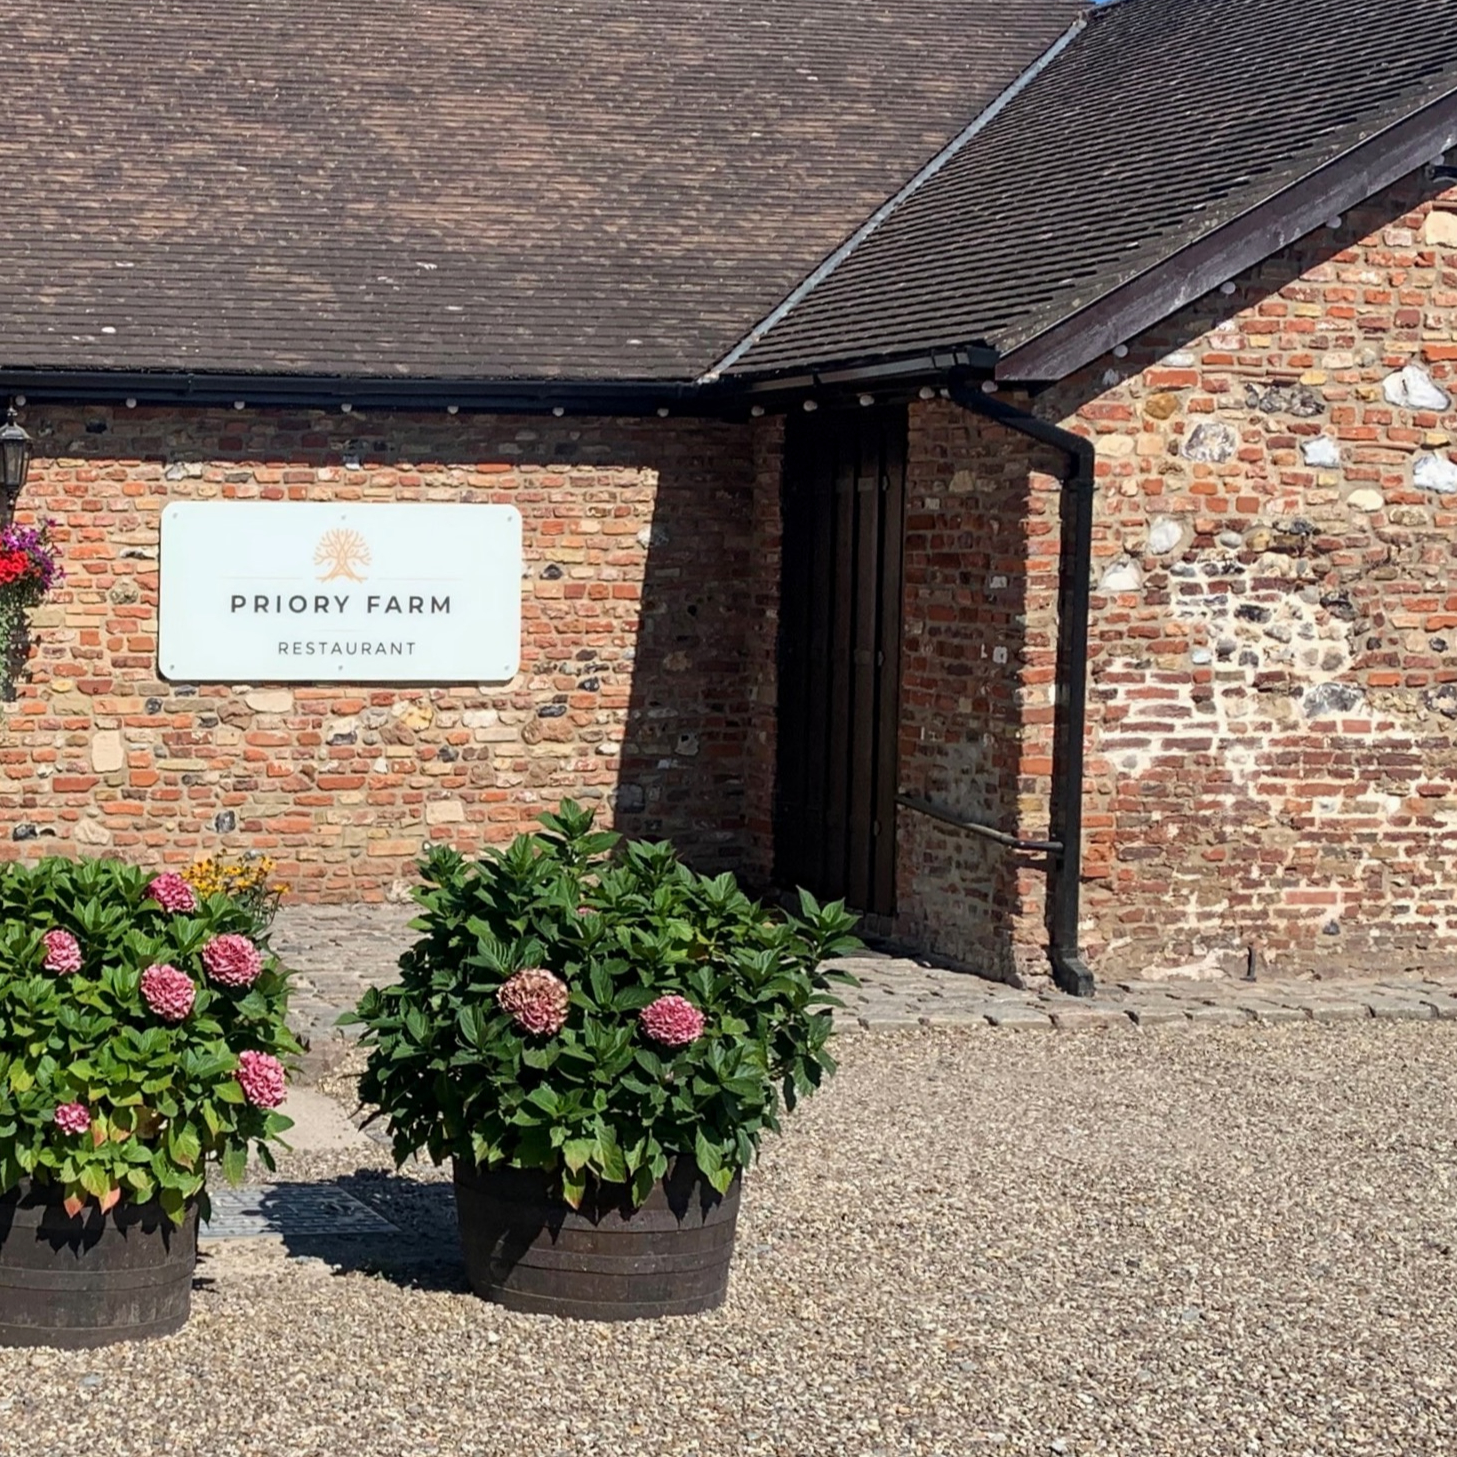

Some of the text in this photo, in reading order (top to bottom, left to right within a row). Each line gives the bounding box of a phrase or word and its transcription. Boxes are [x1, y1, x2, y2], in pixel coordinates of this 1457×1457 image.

[230, 594, 452, 615] PRIORY FARM
[277, 641, 417, 656] RESTAURANT
